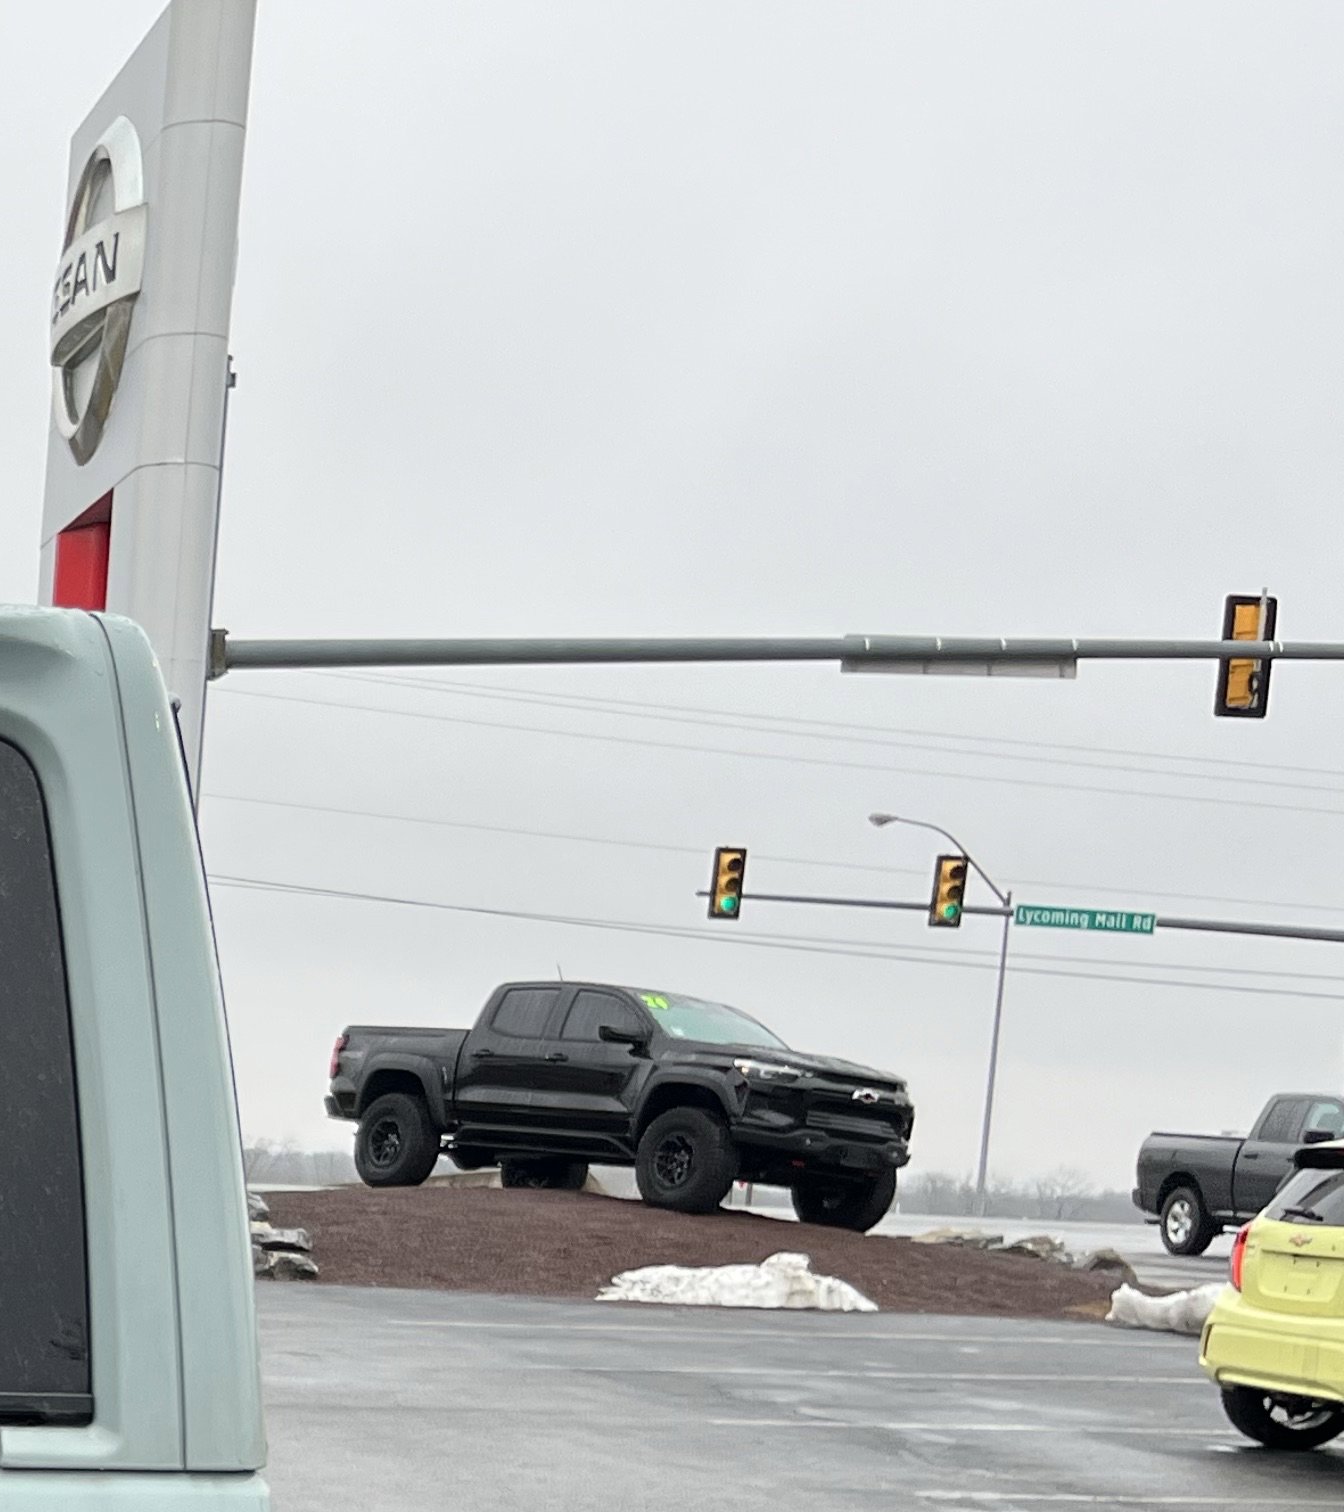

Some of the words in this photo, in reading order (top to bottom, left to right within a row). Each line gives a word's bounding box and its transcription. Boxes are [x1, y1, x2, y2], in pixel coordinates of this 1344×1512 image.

[1018, 906, 1090, 930] Lycoming
[1094, 911, 1127, 929] Mall
[1132, 914, 1153, 931] Rd
